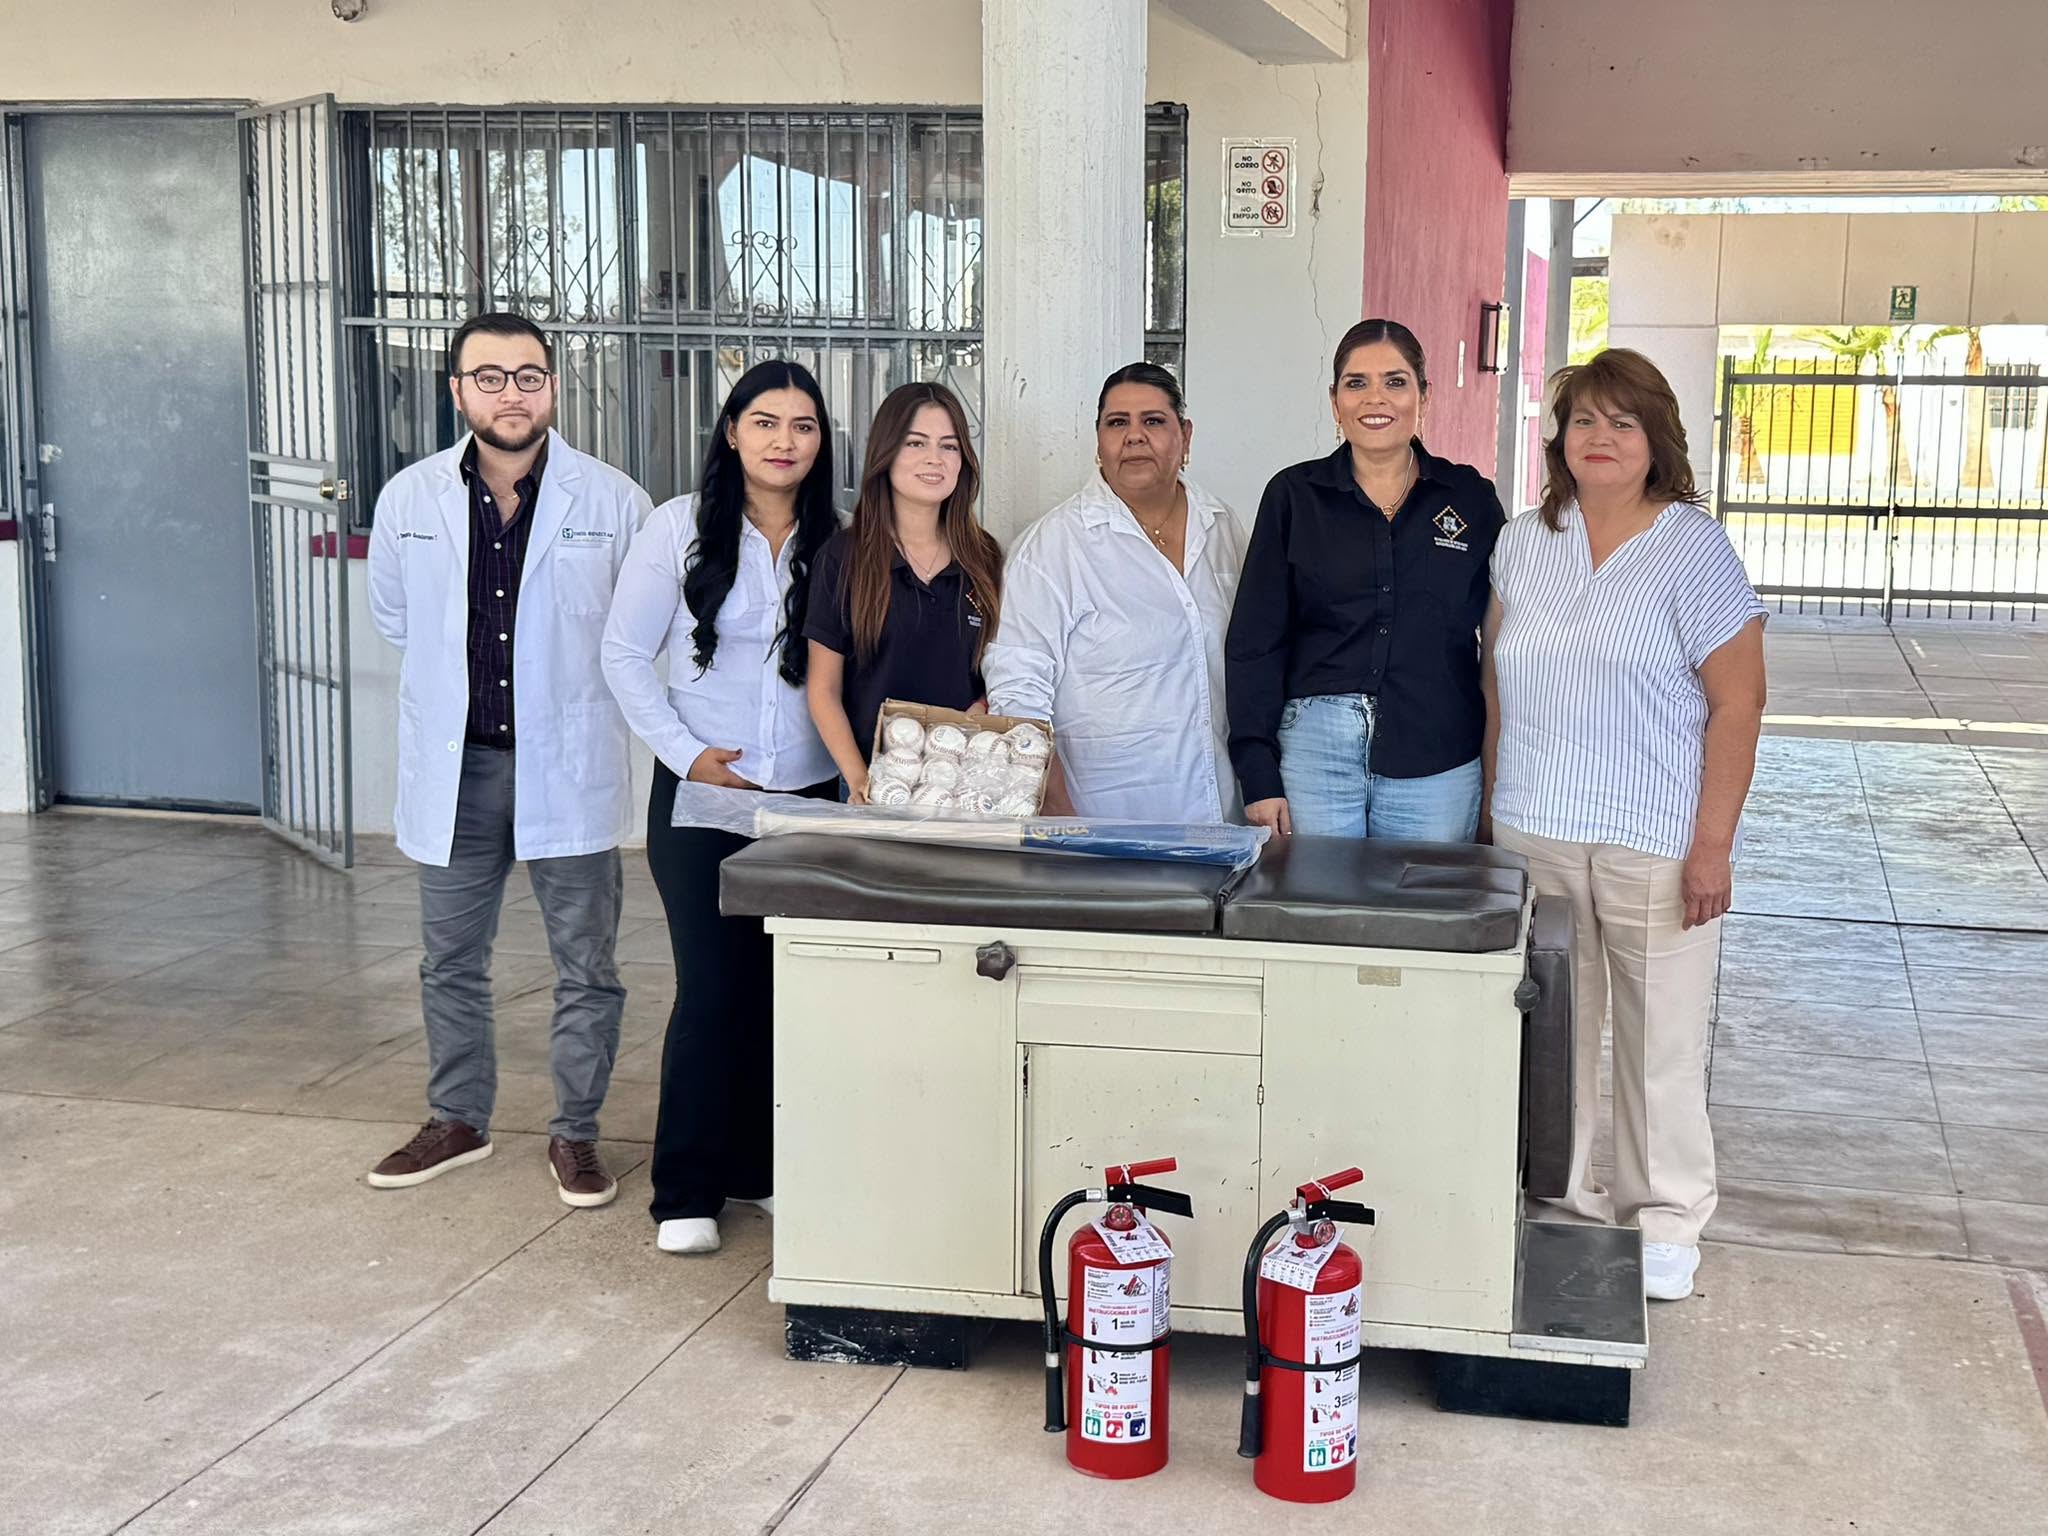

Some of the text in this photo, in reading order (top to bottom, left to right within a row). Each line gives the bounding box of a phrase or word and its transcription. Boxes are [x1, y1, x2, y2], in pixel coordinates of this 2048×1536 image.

[1111, 1317, 1118, 1331] 1
[1335, 1340, 1341, 1354] 1
[1110, 1371, 1118, 1384] 3
[1334, 1370, 1342, 1382] 2
[1334, 1396, 1341, 1408] 3
